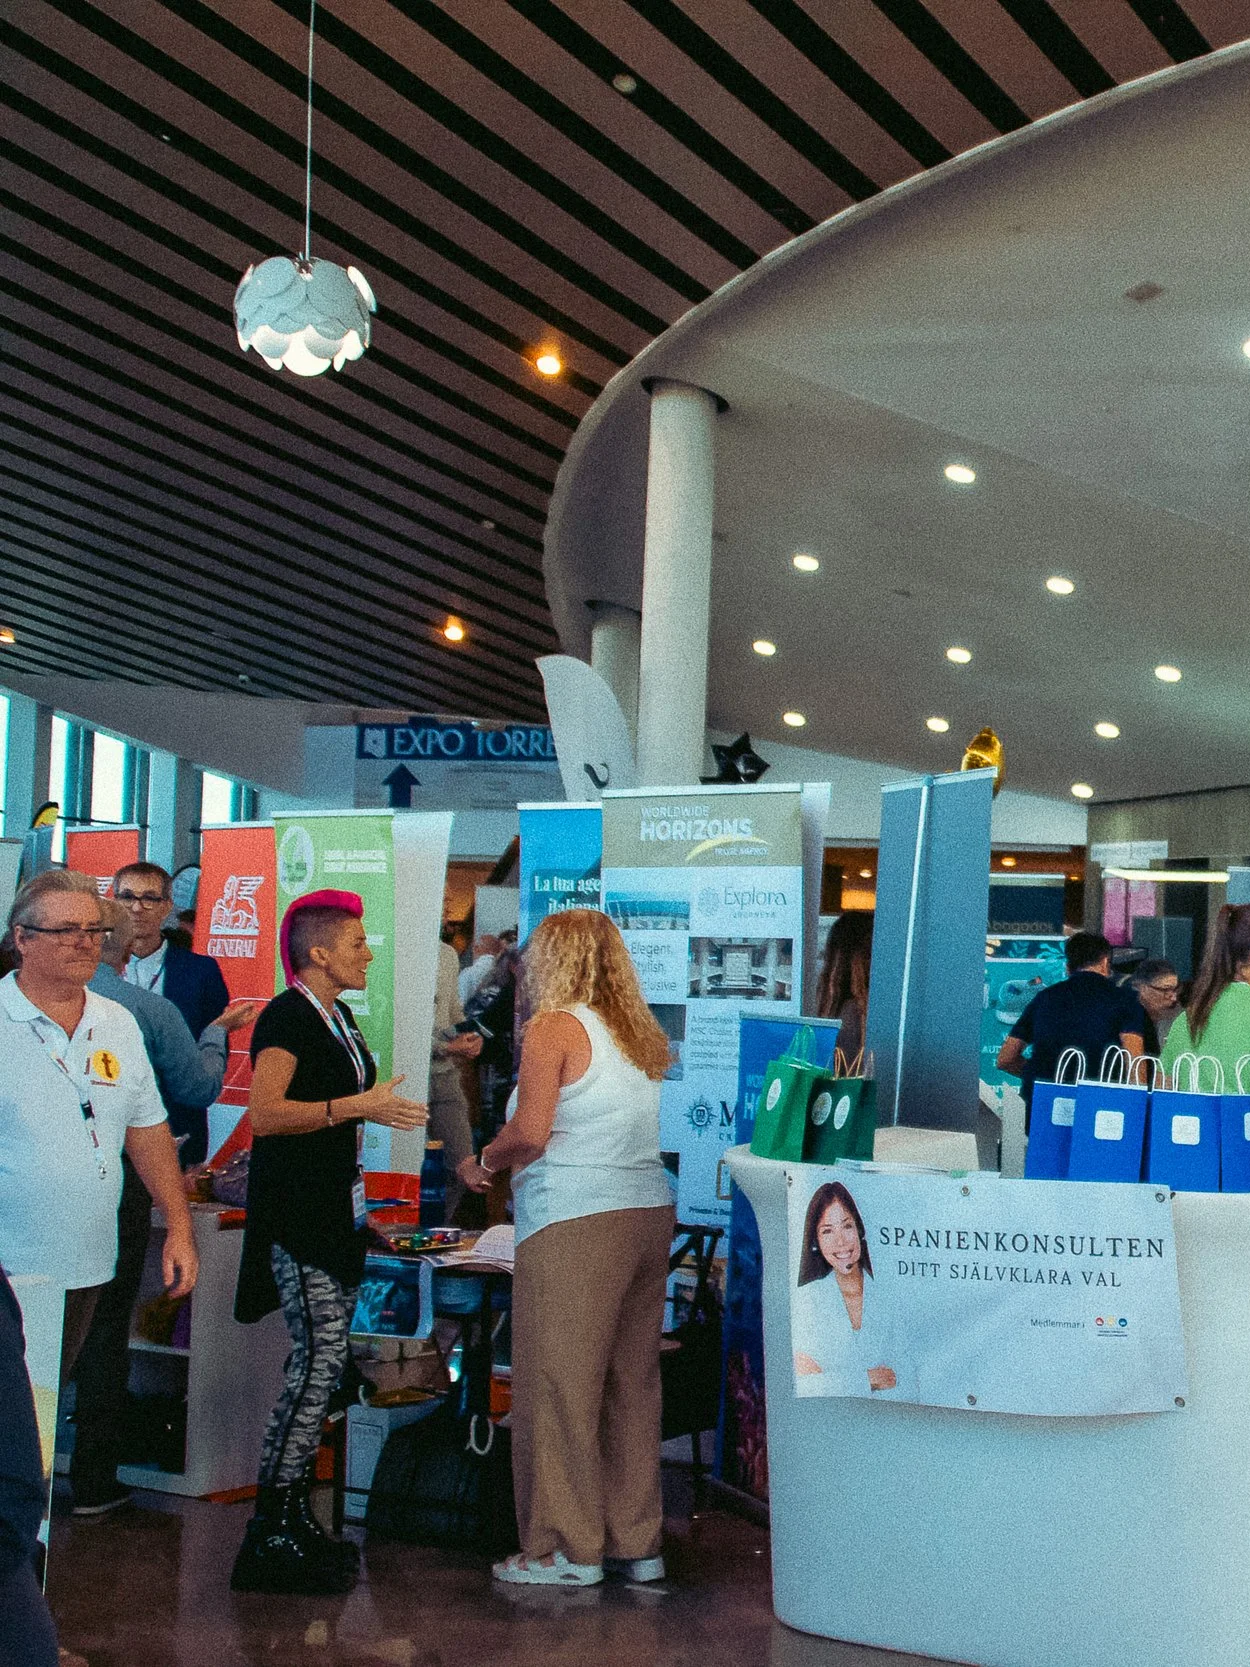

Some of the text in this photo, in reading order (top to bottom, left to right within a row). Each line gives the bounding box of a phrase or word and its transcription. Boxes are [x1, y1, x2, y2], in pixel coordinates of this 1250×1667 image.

[393, 730, 464, 755] EXPO
[641, 805, 710, 818] WORLDWIDE
[640, 818, 753, 841] HORIZONS
[534, 875, 550, 892] La
[724, 886, 788, 910] Explora
[987, 920, 1056, 935] bogados
[207, 938, 258, 958] GENERALI
[878, 1226, 1165, 1259] SPANIENKONSULTEN
[897, 1260, 1122, 1288] DITT SJÄLVKLARA VAL
[1030, 1318, 1080, 1329] Medlemmar
